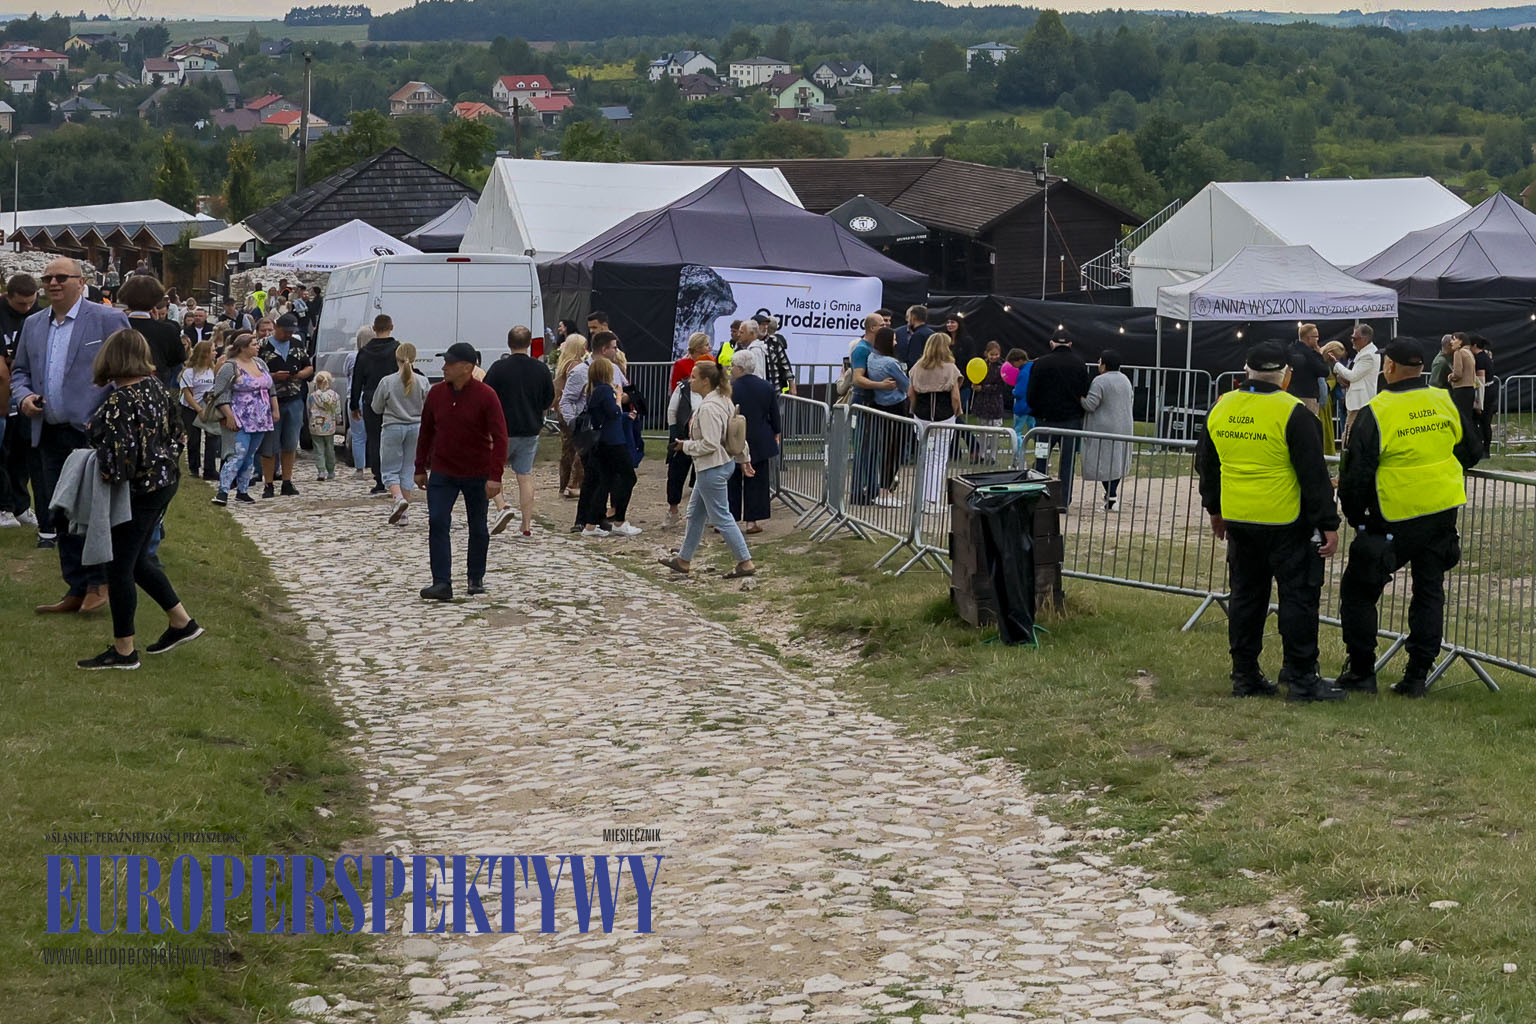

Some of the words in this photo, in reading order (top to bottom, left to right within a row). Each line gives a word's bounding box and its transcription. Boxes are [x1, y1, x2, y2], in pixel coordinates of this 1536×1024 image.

[785, 296, 821, 310] Miasto
[829, 299, 862, 312] Gmina
[1213, 298, 1247, 315] ANNA
[1248, 298, 1306, 315] WYSZKONI
